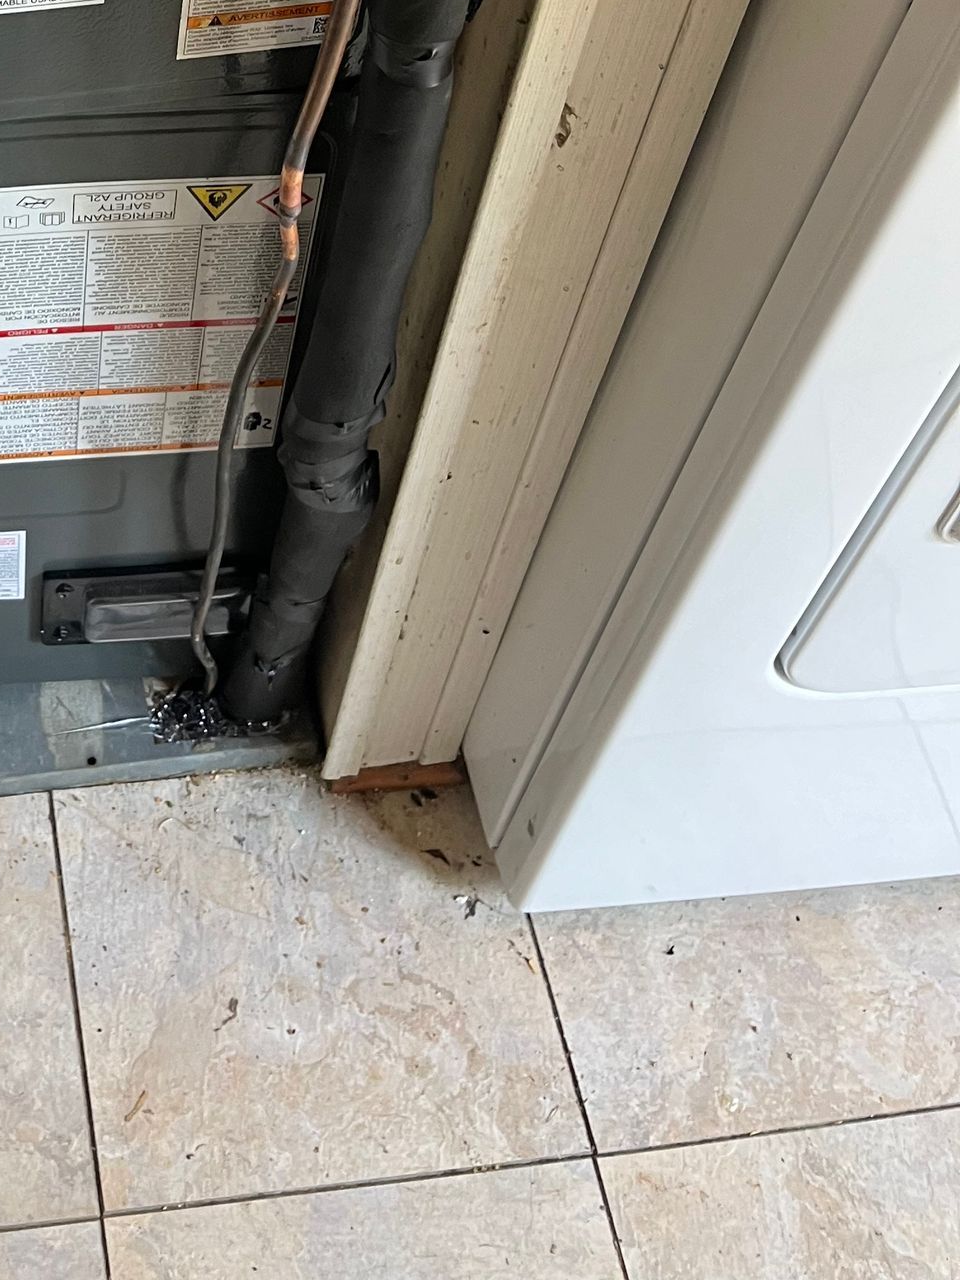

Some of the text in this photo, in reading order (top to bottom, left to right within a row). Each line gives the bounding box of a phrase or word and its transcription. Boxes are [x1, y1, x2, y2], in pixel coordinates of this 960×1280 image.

[228, 6, 320, 22] AVERTISSEMENT
[85, 189, 164, 204] GROUP A2L
[97, 200, 150, 212] SAFETY
[75, 208, 172, 223] REFRIGERANT
[7, 328, 48, 336] PELIGRO
